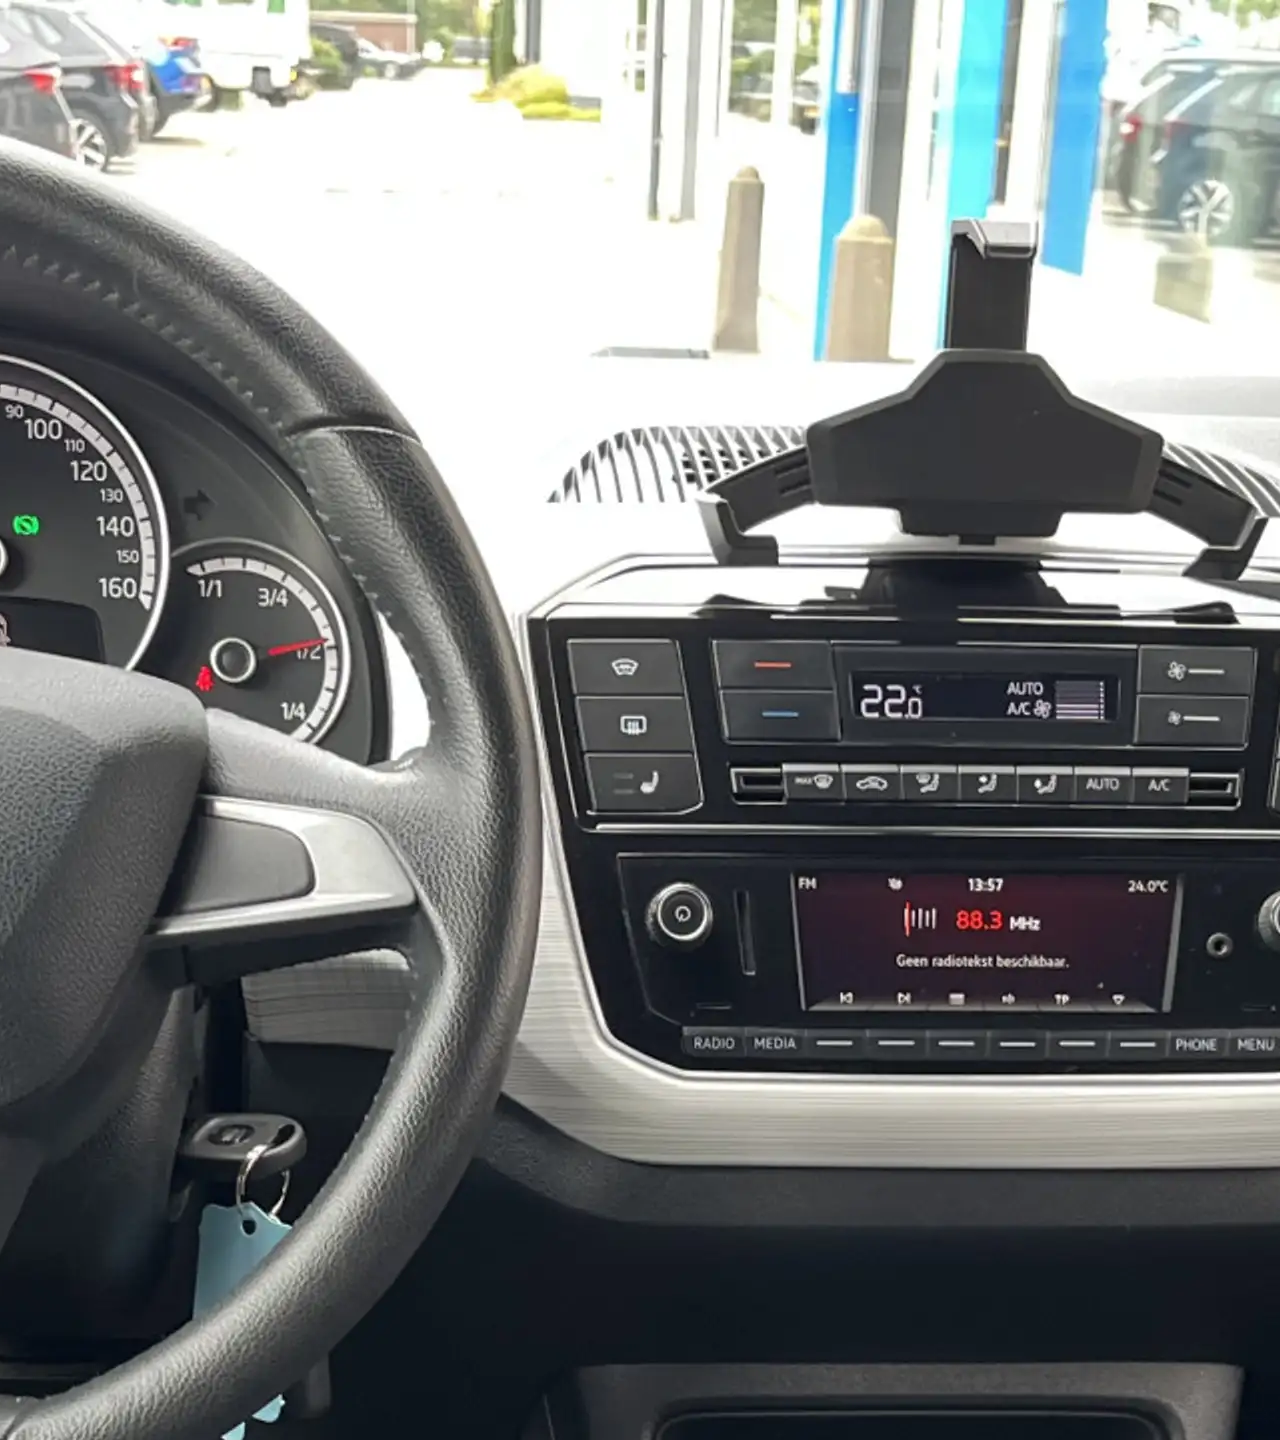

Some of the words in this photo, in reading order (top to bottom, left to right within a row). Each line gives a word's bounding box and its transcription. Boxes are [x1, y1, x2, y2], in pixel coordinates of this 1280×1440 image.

[4, 404, 24, 419] 90
[24, 418, 63, 440] 100
[64, 439, 85, 452] 110
[70, 460, 108, 481] 120
[100, 488, 123, 503] 130
[96, 515, 135, 537] 140
[116, 549, 139, 564] 150
[98, 577, 137, 599] 160
[198, 579, 223, 598] 1/1
[258, 587, 289, 608] 3/4
[1007, 682, 1045, 696] AUTO
[860, 684, 923, 719] 22.0
[1007, 701, 1031, 716] A/C
[280, 702, 307, 721] 1/4
[1086, 778, 1120, 791] AUTO
[1148, 778, 1171, 792] A/C
[798, 877, 818, 890] FM
[968, 877, 1003, 892] 13:57
[956, 910, 1003, 930] 88.3
[1009, 917, 1041, 931] MHz
[896, 953, 928, 968] Geen
[932, 952, 993, 968] radiotekst
[996, 954, 1070, 969] beschikbaar.
[694, 1036, 735, 1050] RADIO
[754, 1036, 797, 1050] MEDIA
[1175, 1038, 1217, 1052] PHONE
[1237, 1038, 1275, 1052] MENU
